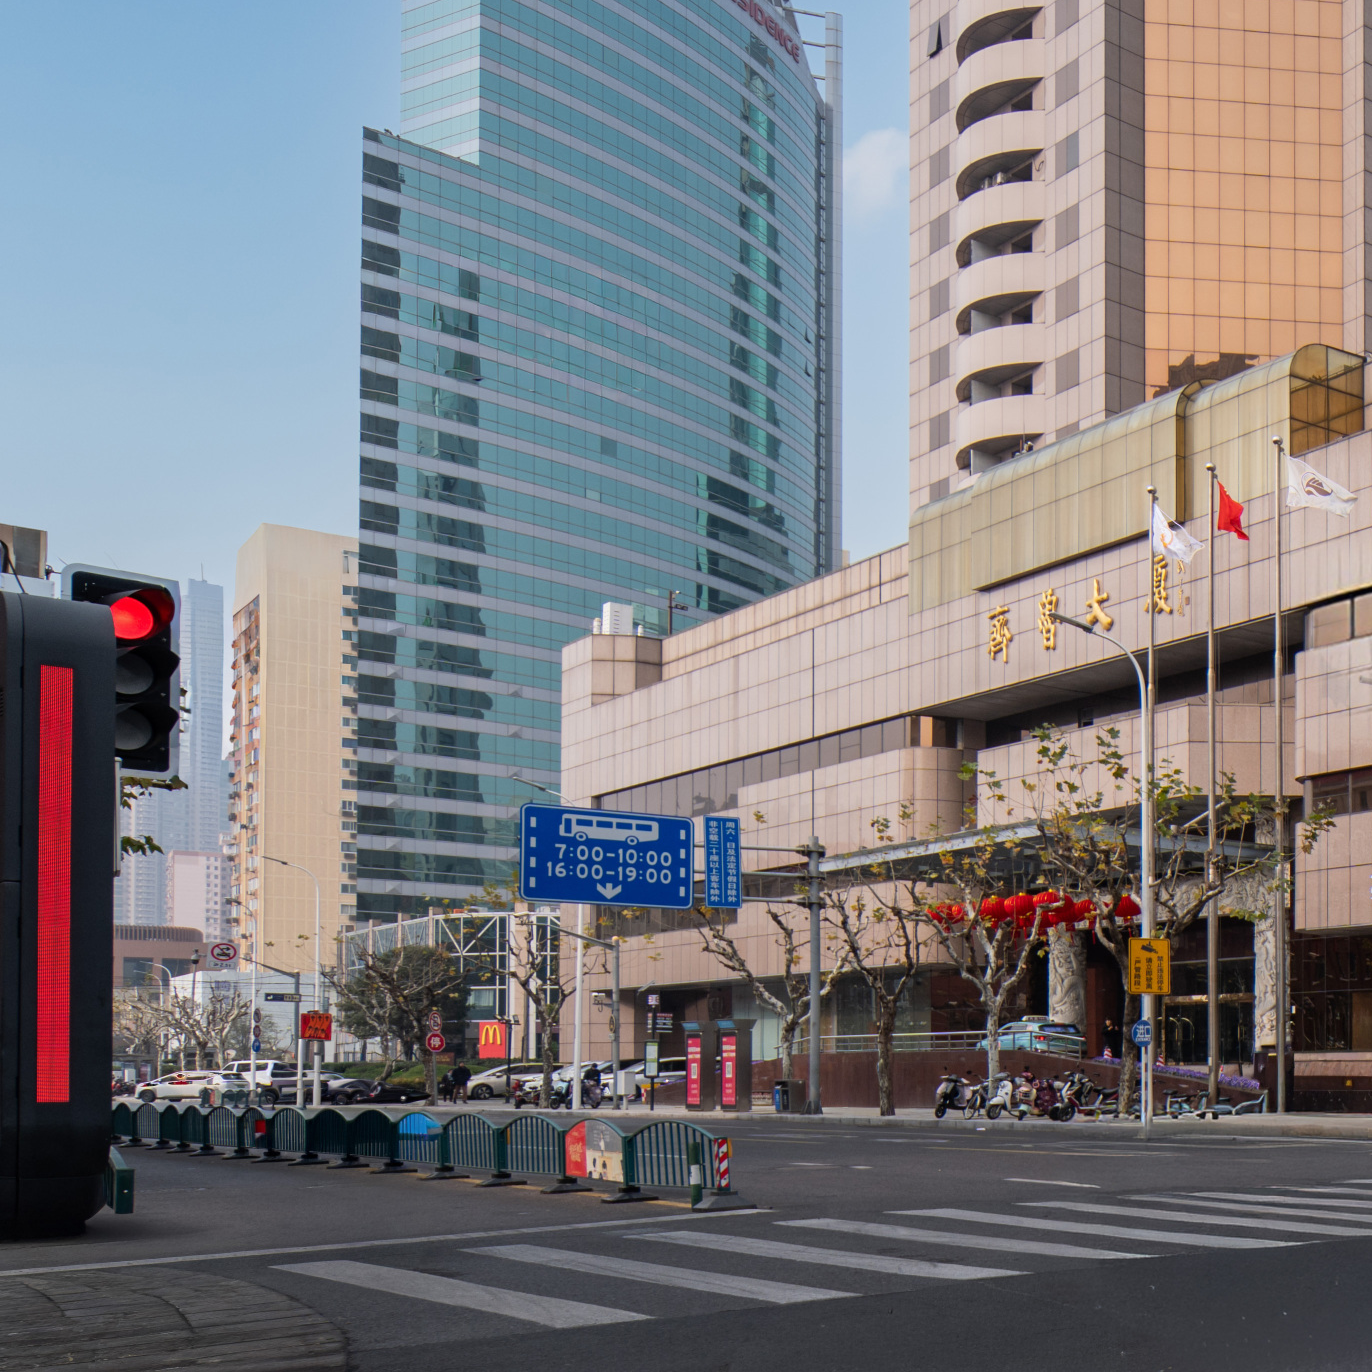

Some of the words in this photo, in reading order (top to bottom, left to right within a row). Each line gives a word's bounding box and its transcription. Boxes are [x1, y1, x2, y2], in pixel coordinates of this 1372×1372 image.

[554, 843, 672, 867] 7:00-10:00
[546, 861, 673, 885] 16:00-19:00
[1136, 1025, 1152, 1038] 进口
[430, 1036, 442, 1048] 停
